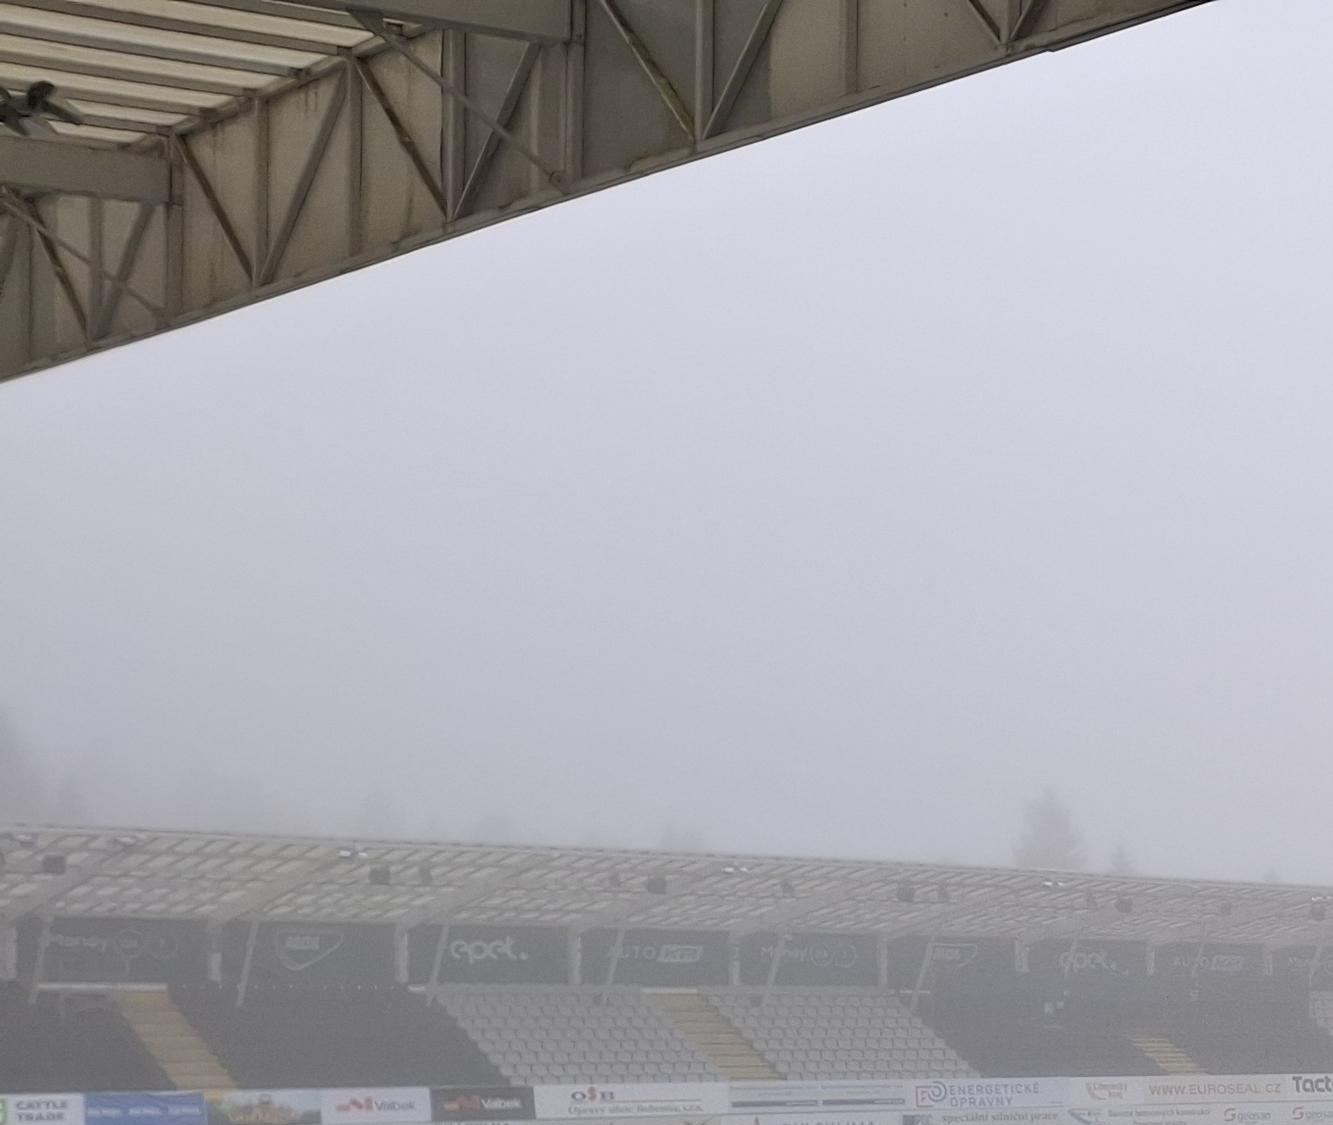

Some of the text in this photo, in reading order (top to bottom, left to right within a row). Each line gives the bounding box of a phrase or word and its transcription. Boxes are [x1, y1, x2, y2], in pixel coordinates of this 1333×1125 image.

[949, 1082, 1040, 1096] ENERGETICKÉ
[15, 1100, 68, 1111] CATTLE
[374, 1100, 416, 1112] Valbek
[481, 1097, 522, 1110] Valbek
[950, 1096, 1014, 1108] OPRAVNY
[16, 1112, 66, 1122] TRADE
